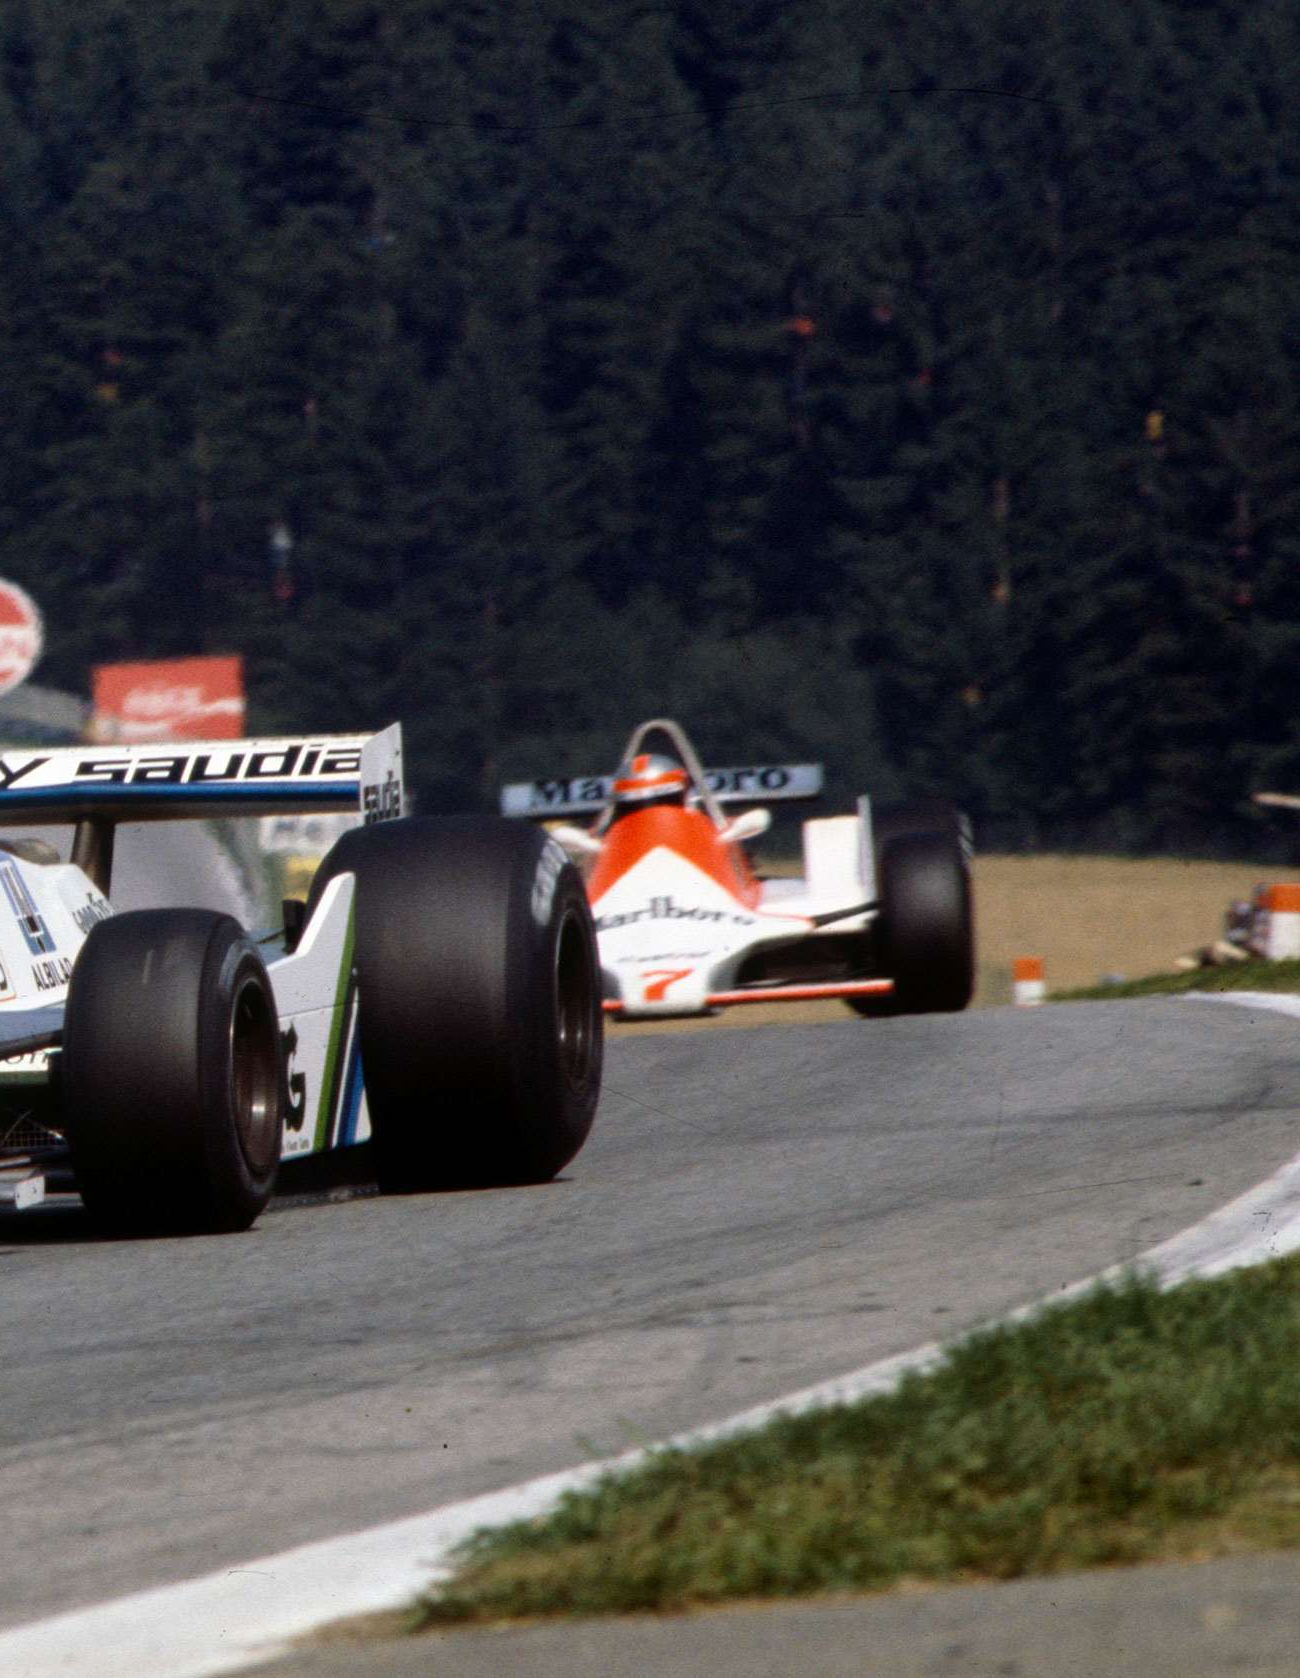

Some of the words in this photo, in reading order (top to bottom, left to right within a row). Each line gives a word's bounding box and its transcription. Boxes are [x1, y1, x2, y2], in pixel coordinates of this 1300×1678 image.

[74, 745, 361, 783] saudia
[533, 767, 789, 805] Maoro
[640, 968, 693, 1000] 7
